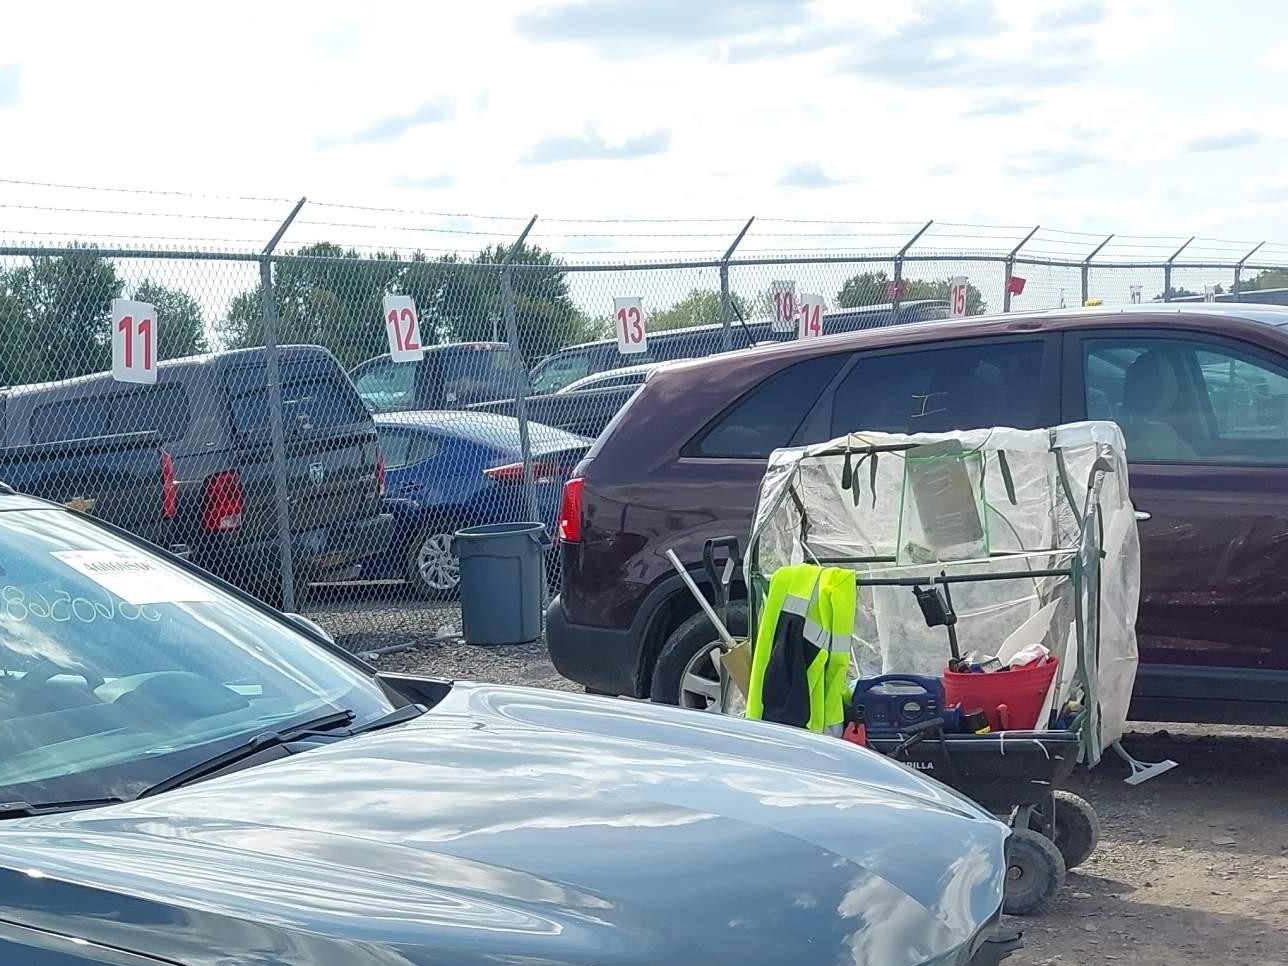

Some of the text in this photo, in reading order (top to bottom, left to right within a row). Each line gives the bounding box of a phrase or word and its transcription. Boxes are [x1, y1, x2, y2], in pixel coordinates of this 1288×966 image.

[774, 291, 793, 322] 10
[952, 285, 965, 314] 15
[388, 308, 420, 352] 12
[617, 306, 643, 344] 13
[801, 304, 821, 337] 14
[118, 315, 151, 370] 11
